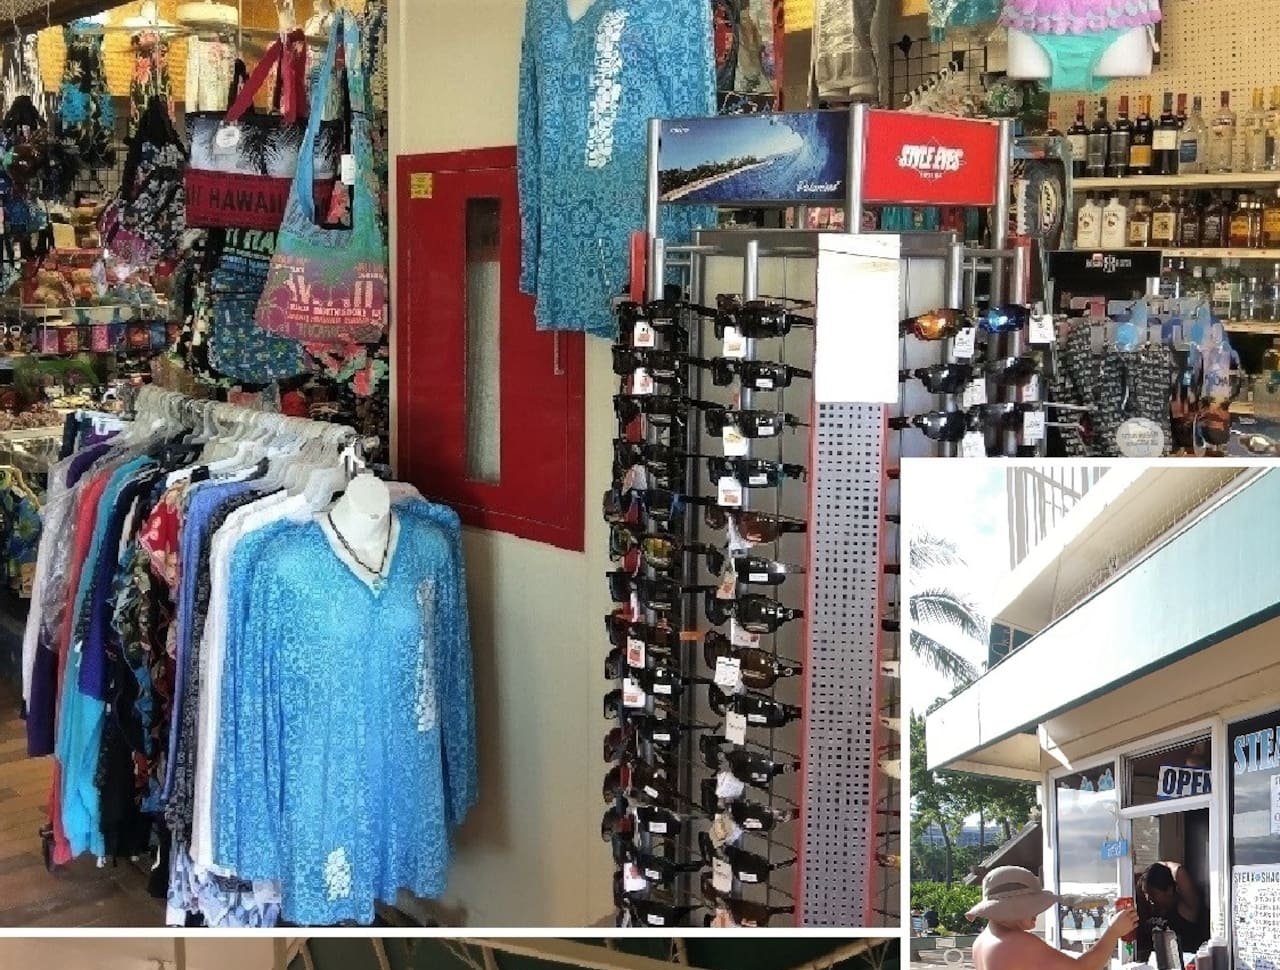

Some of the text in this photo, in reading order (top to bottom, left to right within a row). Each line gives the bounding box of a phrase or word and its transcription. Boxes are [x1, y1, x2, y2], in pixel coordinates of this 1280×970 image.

[208, 186, 283, 214] HAWAII
[1162, 765, 1212, 797] OPEN
[1233, 871, 1256, 883] STEAK
